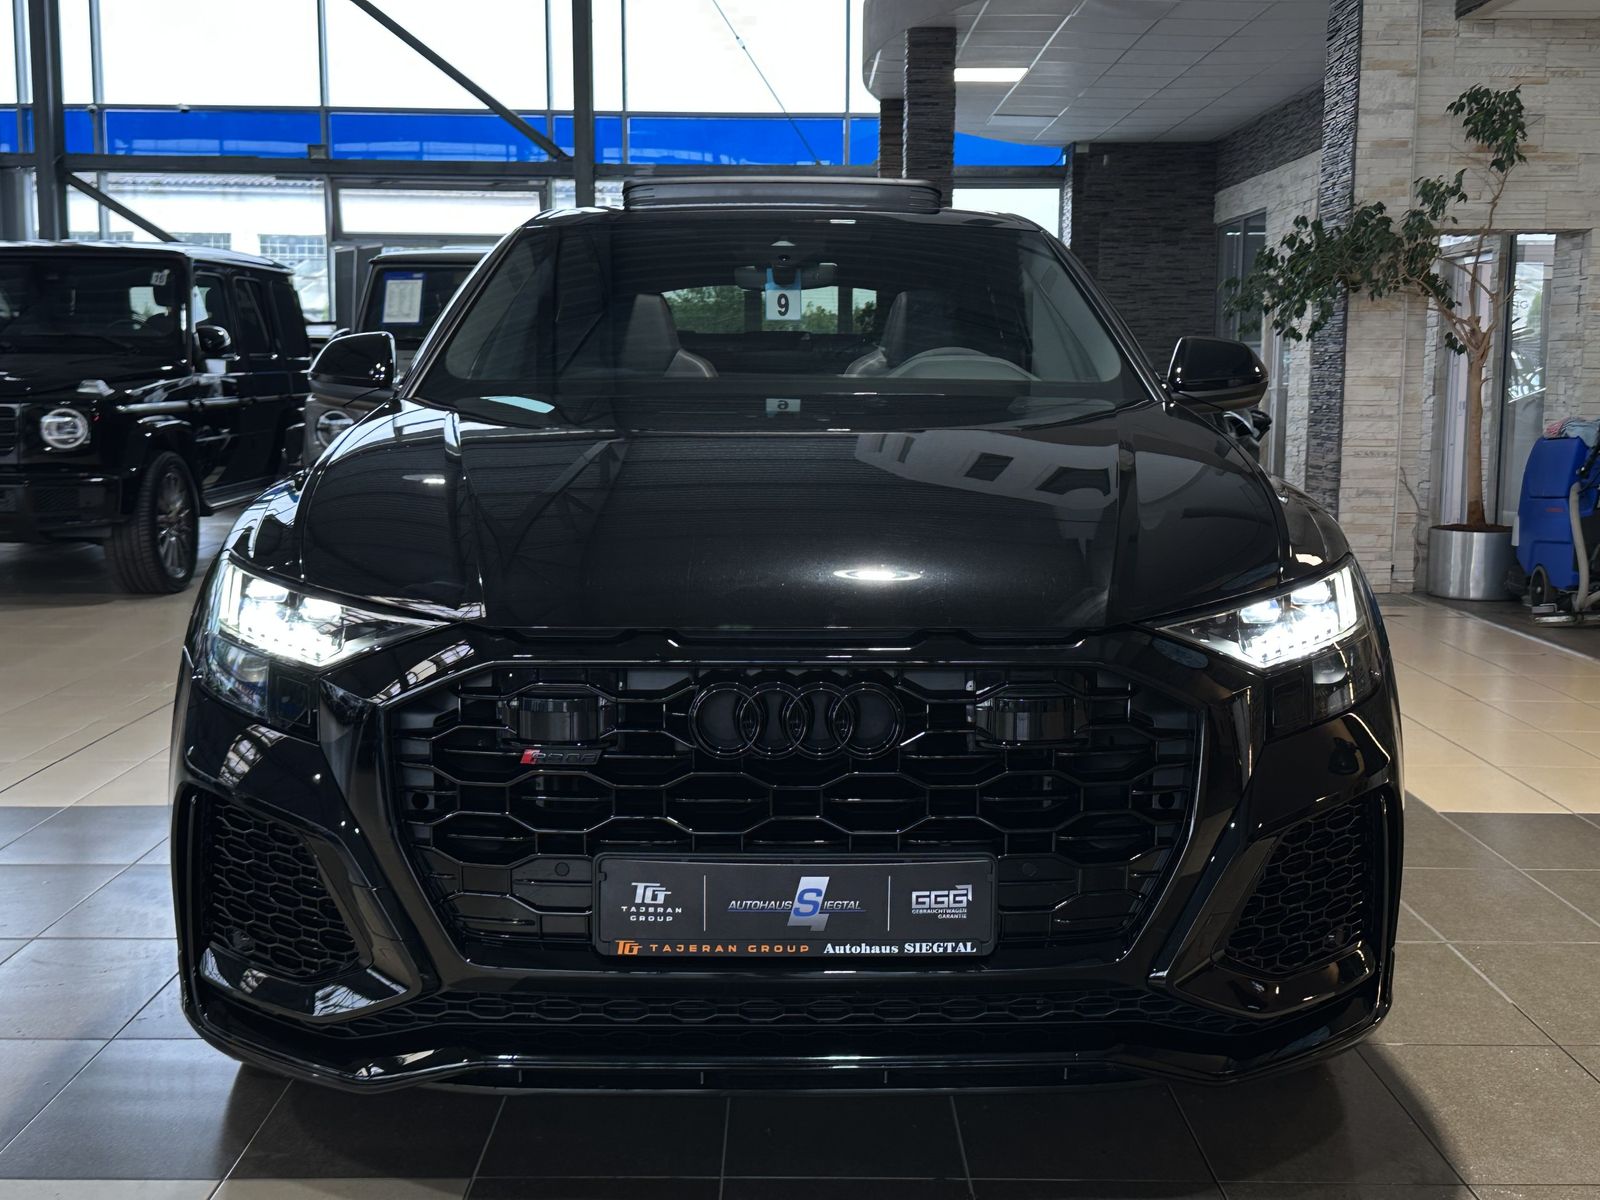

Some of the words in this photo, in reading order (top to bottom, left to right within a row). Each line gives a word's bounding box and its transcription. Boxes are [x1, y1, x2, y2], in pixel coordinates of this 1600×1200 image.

[777, 293, 789, 316] 9
[911, 888, 968, 909] GGG
[728, 900, 793, 910] AUTOHAUS
[649, 944, 738, 953] TAJERAN
[747, 944, 809, 953] GROUP
[823, 942, 899, 954] Autohaus
[904, 942, 977, 954] SIEGTAL
